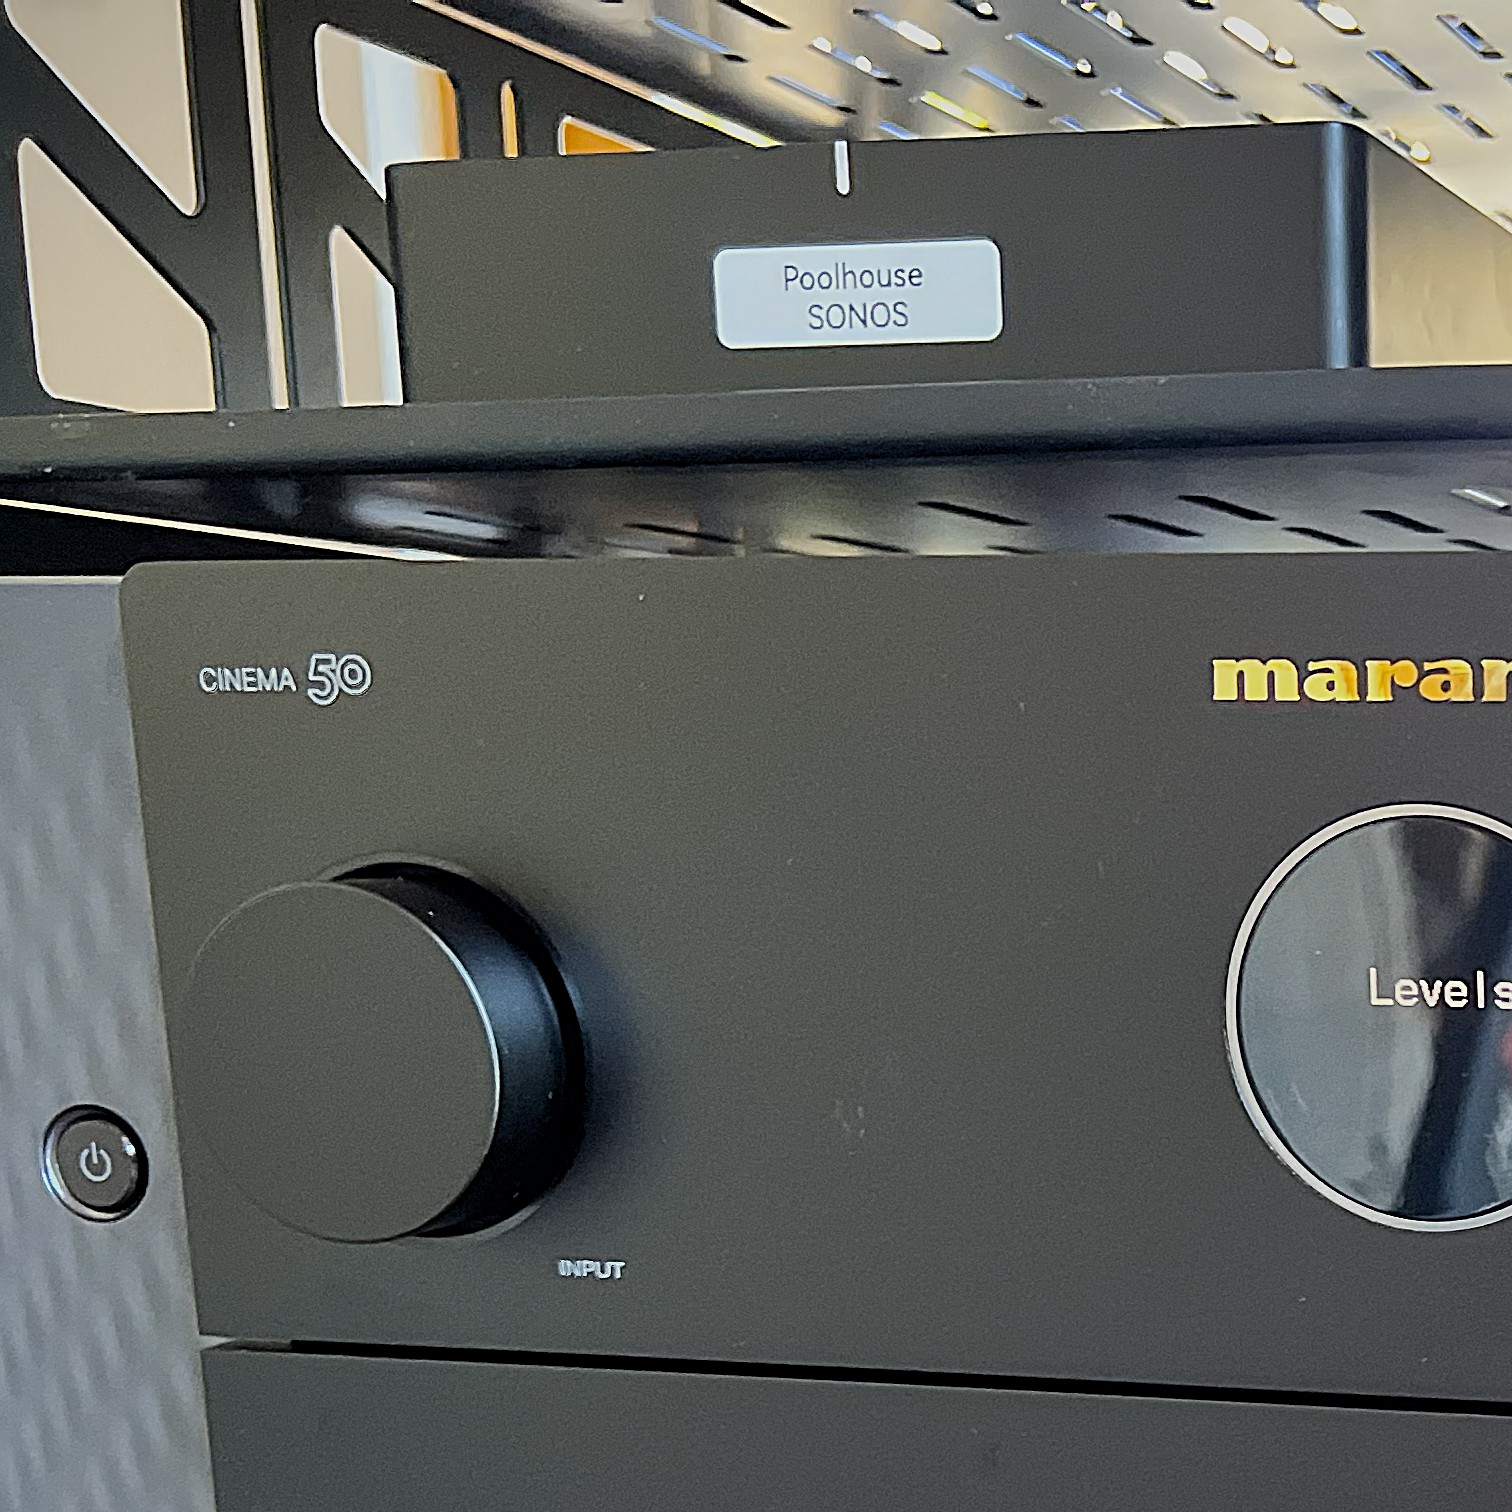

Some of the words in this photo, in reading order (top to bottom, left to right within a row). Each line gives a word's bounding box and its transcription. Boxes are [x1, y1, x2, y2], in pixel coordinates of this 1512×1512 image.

[783, 262, 923, 291] Poolhouse
[807, 301, 909, 330] SONOS
[199, 667, 298, 693] CINEMA
[307, 653, 372, 706] 50
[558, 1259, 626, 1279] INPUT
